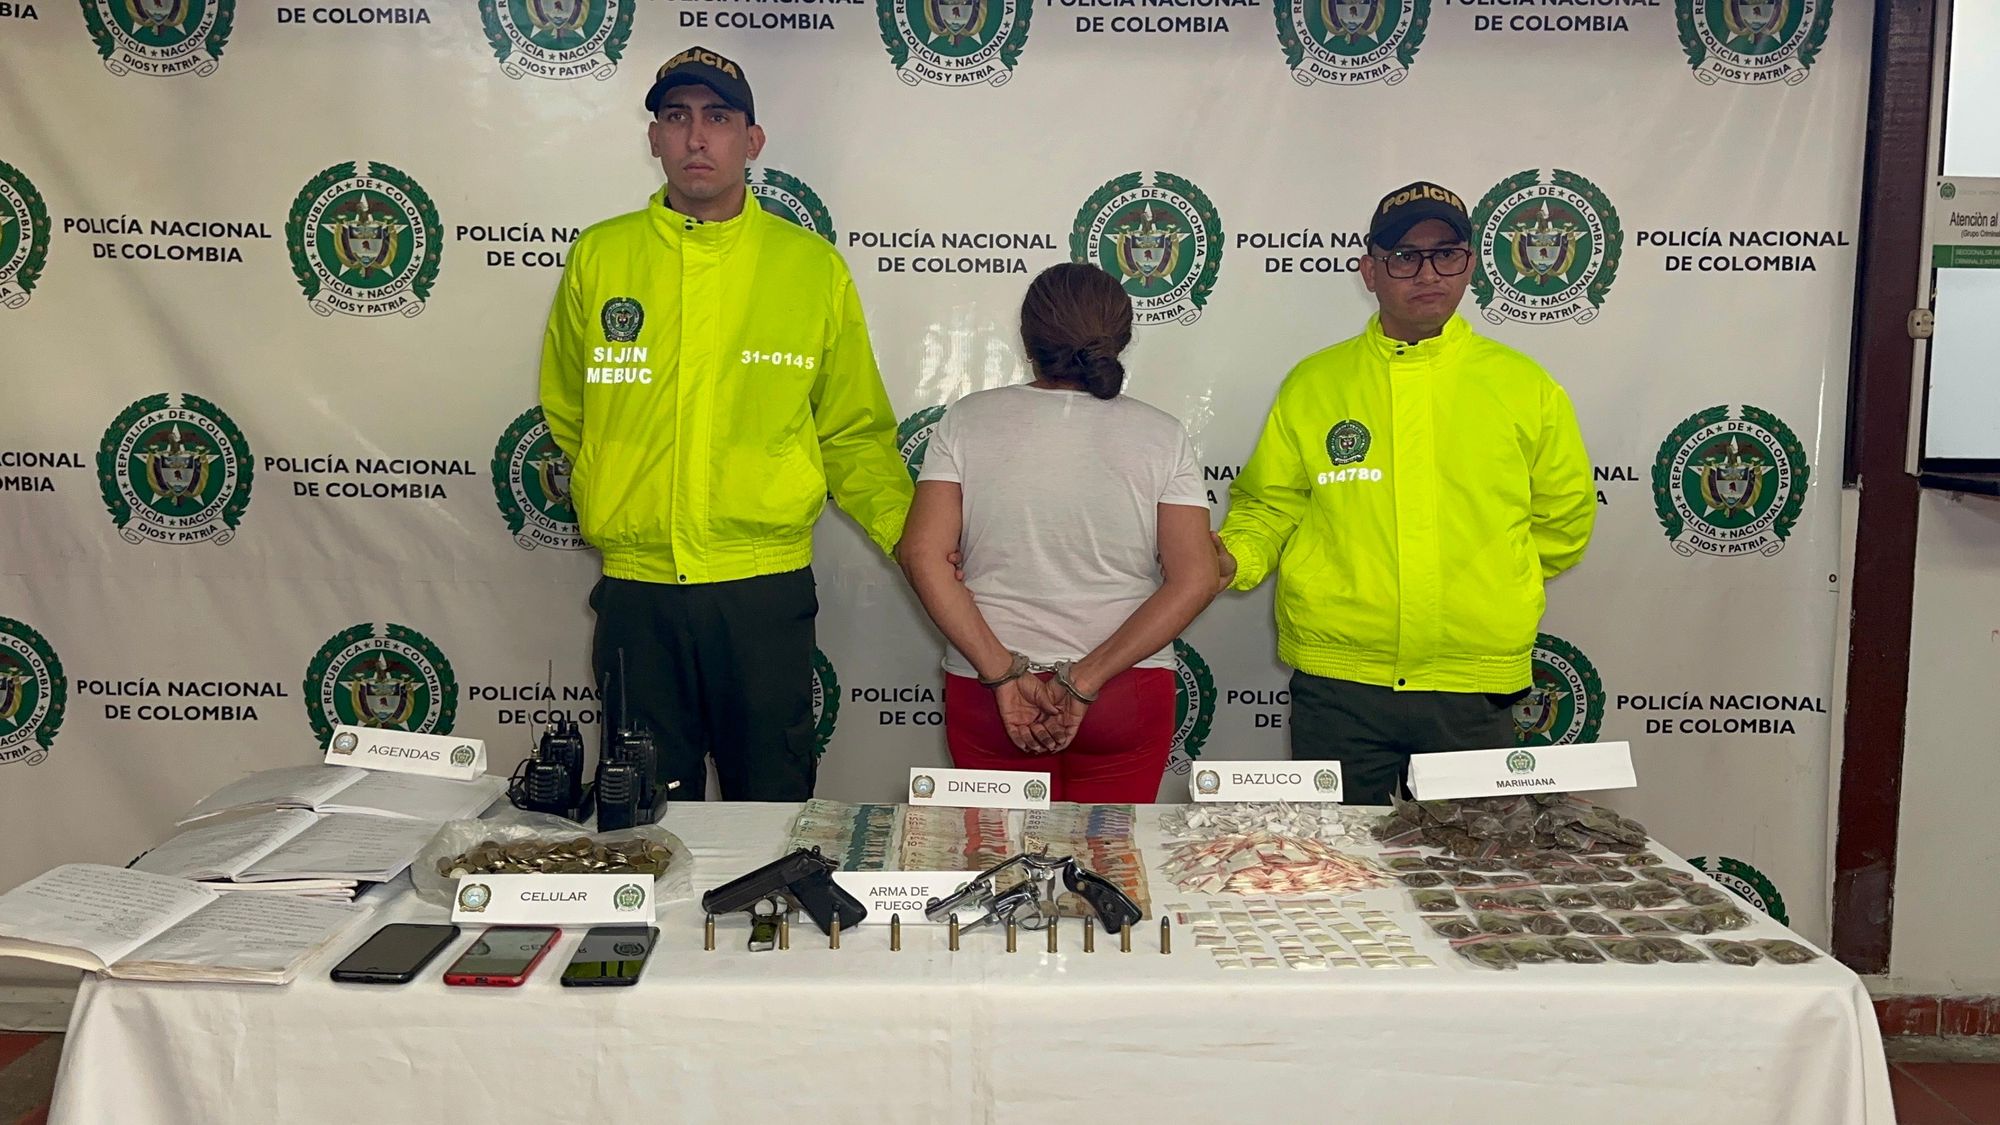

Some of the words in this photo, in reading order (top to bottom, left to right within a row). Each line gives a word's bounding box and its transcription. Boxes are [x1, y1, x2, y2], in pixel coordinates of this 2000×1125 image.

[278, 8, 305, 23] DE
[313, 8, 430, 23] COLOMBIA
[680, 12, 707, 27] DE
[715, 12, 834, 29] COLOMBIA
[1077, 17, 1103, 32] DE
[1111, 17, 1229, 32] COLOMBIA
[1475, 16, 1502, 30] DE
[1510, 16, 1628, 31] COLOMBIA
[161, 20, 211, 57] NACIONAL
[559, 24, 612, 61] NACIONAL
[1351, 28, 1406, 66] NACIONAL
[1753, 29, 1808, 66] NACIONAL
[955, 30, 1009, 67] NACIONAL
[122, 54, 150, 72] DIOS
[151, 63, 158, 72] Y
[162, 55, 201, 73] PATRIA
[518, 57, 546, 75] DIOS
[548, 66, 555, 75] Y
[559, 58, 599, 76] PATRIA
[660, 49, 738, 79] POLICIA
[915, 63, 943, 82] DIOS
[944, 73, 952, 82] Y
[955, 64, 995, 83] PATRIA
[1309, 63, 1338, 82] DIOS
[1339, 72, 1347, 81] Y
[1350, 63, 1391, 82] PATRIA
[1712, 63, 1740, 81] DIOS
[1741, 72, 1749, 81] Y
[1752, 63, 1793, 81] PATRIA
[1382, 185, 1463, 213] POLICIA
[0, 184, 31, 241] OLOMBIA
[356, 179, 373, 188] DE
[385, 186, 424, 249] COLOMBIA
[780, 193, 815, 231] COLOM
[1538, 187, 1555, 196] DE
[1567, 193, 1603, 255] COLOMBIA
[1990, 211, 1998, 226] al
[64, 215, 142, 234] POLICÍA
[151, 221, 271, 238] NACIONAL
[457, 223, 545, 242] POLICÍA
[1142, 189, 1158, 198] DE
[1170, 196, 1205, 257] COLOMBIA
[850, 229, 935, 248] POLICÍA
[943, 234, 1056, 249] NACIONAL
[1237, 229, 1324, 248] POLICÍA
[1637, 227, 1722, 246] POLICÍA
[1730, 231, 1849, 246] NACIONAL
[93, 244, 117, 258] DE
[122, 244, 242, 262] COLOMBIA
[488, 251, 515, 266] DE
[0, 254, 26, 280] ONAL
[879, 257, 905, 272] DE
[912, 258, 1027, 273] COLOMBIA
[1266, 258, 1293, 272] DE
[1300, 258, 1360, 273] COLO
[1666, 256, 1692, 271] DE
[1699, 256, 1816, 271] COLOMBIA
[367, 263, 420, 299] NACIONAL
[1146, 271, 1199, 307] NACIONAL
[1541, 269, 1596, 306] NACIONAL
[327, 295, 355, 312] DIOS
[356, 304, 364, 313] Y
[367, 296, 407, 314] PATRIA
[1135, 313, 1142, 322] Y
[1145, 304, 1185, 322] PATRIA
[1499, 303, 1528, 320] DIOS
[1529, 312, 1537, 320] Y
[1540, 303, 1581, 321] PATRIA
[593, 346, 648, 363] SIJIN
[741, 351, 815, 370] 31-0145
[586, 367, 652, 384] MEBUC
[169, 411, 185, 419] DE
[198, 417, 235, 478] COLOMBIA
[901, 427, 934, 463] BLICA
[0, 451, 86, 469] CIONAL
[265, 455, 349, 473] POLICÍA
[357, 459, 476, 475] NACIONAL
[1726, 422, 1742, 431] DE
[1754, 429, 1789, 489] COLOMBIA
[0, 475, 56, 492] OMBIA
[1318, 468, 1382, 485] 614780
[294, 482, 319, 496] DE
[326, 483, 446, 498] COLOMBIA
[178, 492, 231, 527] NACIONAL
[1729, 503, 1783, 538] NACIONAL
[138, 523, 166, 540] DIOS
[167, 532, 175, 540] Y
[178, 524, 218, 541] PATRIA
[531, 529, 559, 546] DIOS
[561, 538, 568, 547] Y
[1689, 535, 1716, 552] DIOS
[1718, 544, 1725, 552] Y
[1728, 536, 1768, 553] PATRIA
[11, 640, 48, 699] COLOMBIA
[374, 640, 390, 648] DE
[403, 646, 440, 705] COLOMBIA
[78, 678, 160, 696] POLICÍA
[169, 682, 288, 696] NACIONAL
[470, 682, 556, 700] POLICÍA
[852, 684, 935, 702] POLICÍA
[1174, 658, 1199, 711] LOMBIA
[1550, 656, 1585, 715] COLOMBIA
[1227, 690, 1290, 705] POLIC
[1618, 692, 1703, 710] POLICÍA
[1710, 695, 1826, 713] NACIONAL
[105, 705, 130, 719] DE
[138, 706, 257, 720] COLOMBIA
[499, 710, 525, 724] DE
[533, 710, 601, 725] COLO
[880, 712, 905, 725] DE
[1255, 714, 1281, 727] DE
[0, 712, 44, 746] ACIONAL
[1647, 720, 1673, 733] DE
[1680, 719, 1795, 734] COLOMBIA
[0, 744, 31, 760] ATRIA
[368, 745, 440, 760] AGENDAS
[949, 781, 1010, 793] DINERO
[1233, 774, 1301, 784] BAZUCO
[1496, 778, 1555, 788] MARIHUANA
[521, 892, 587, 901] CELULAR
[869, 887, 907, 896] ARMA
[911, 887, 928, 896] DE
[1734, 881, 1763, 909] COLO
[875, 900, 923, 911] FUEGO
